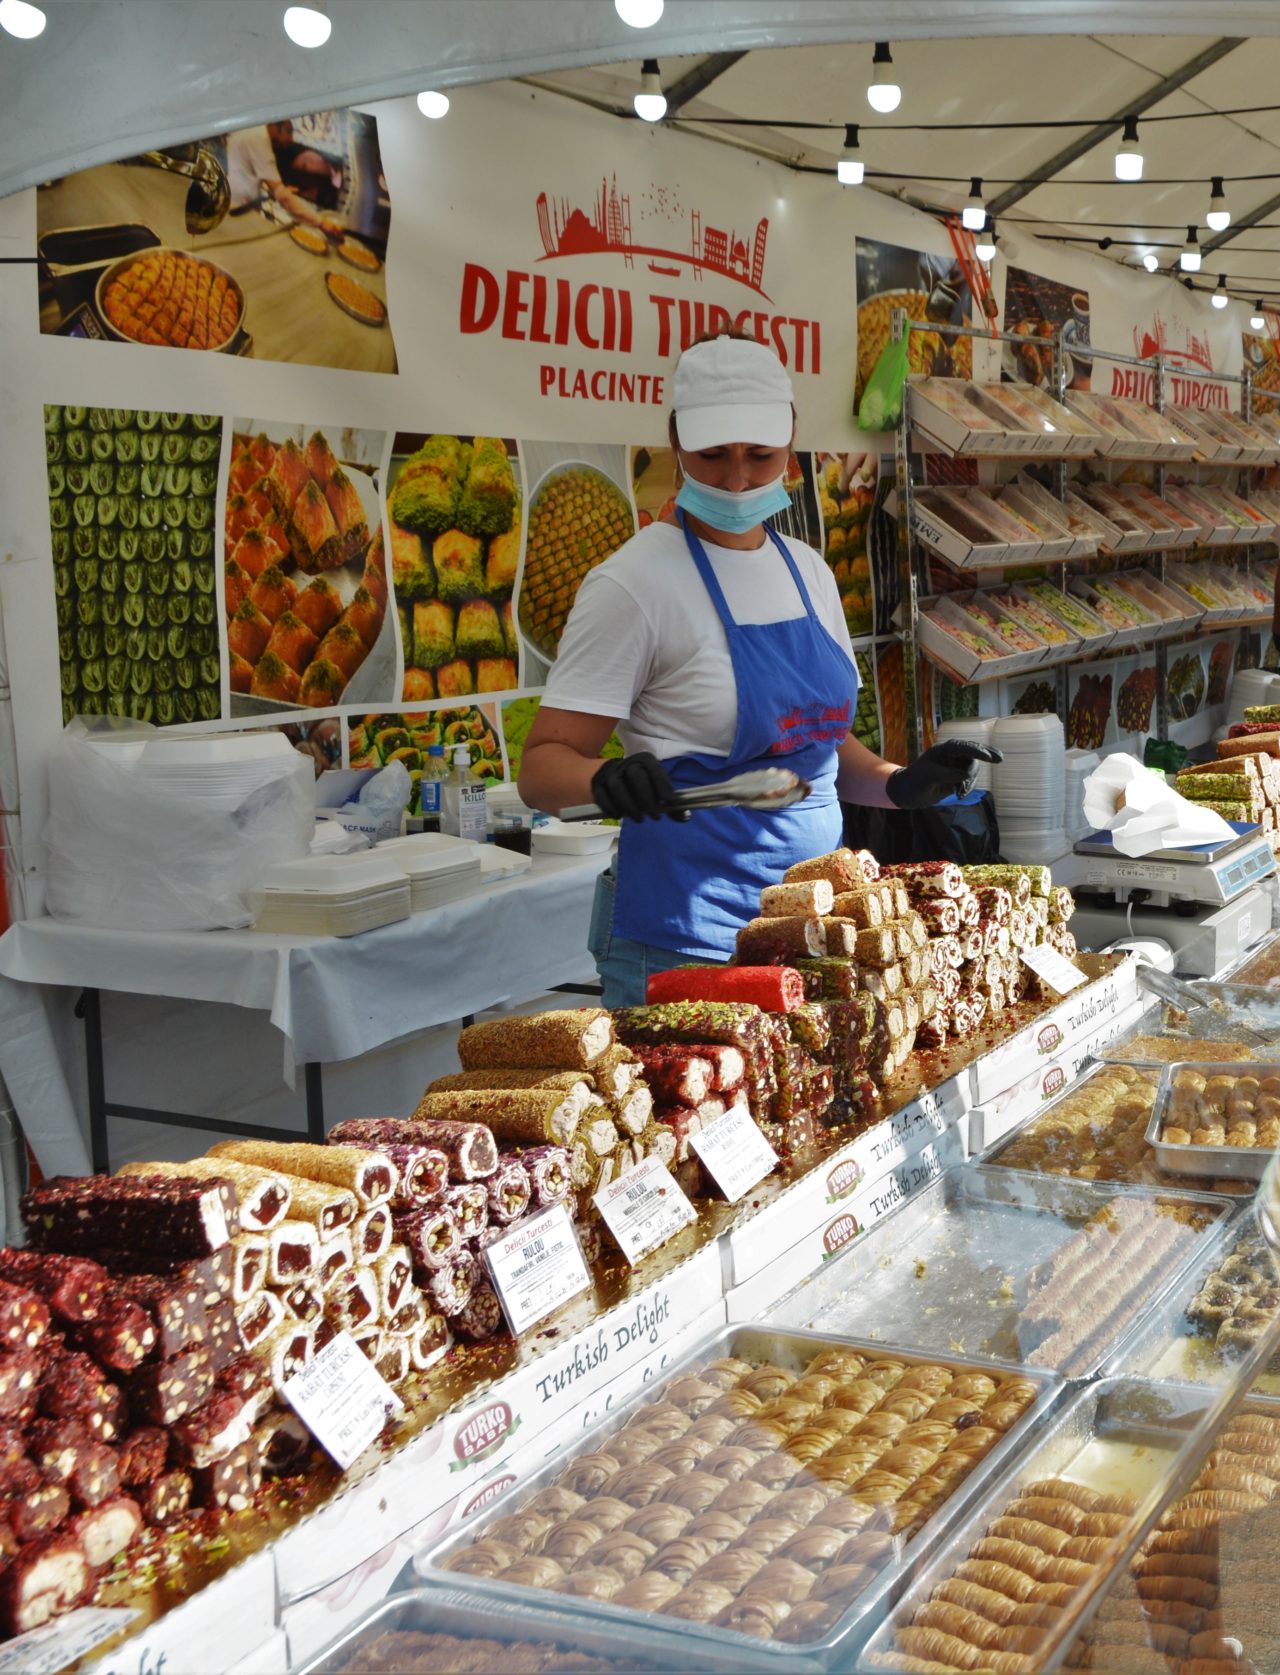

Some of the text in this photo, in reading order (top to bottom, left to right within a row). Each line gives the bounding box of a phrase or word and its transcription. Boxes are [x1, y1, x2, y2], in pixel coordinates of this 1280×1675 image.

[460, 263, 632, 353] DELICII
[540, 365, 665, 405] PLACINTE
[1067, 997, 1097, 1031] Turkish
[870, 1093, 946, 1162] Turkish Delight
[831, 1163, 856, 1184] TURKO
[834, 1173, 858, 1194] BABA
[870, 1148, 942, 1216] Turkish Delight
[625, 1182, 647, 1202] RULOU
[504, 1218, 553, 1254] Delicii Turcesti
[826, 1217, 854, 1243] TURKO
[829, 1230, 856, 1251] BABA
[522, 1238, 545, 1260] RULOU
[536, 1328, 608, 1403] Turkish
[613, 1292, 670, 1351] Delight
[459, 1406, 507, 1447] TURKO
[464, 1423, 508, 1457] BABA
